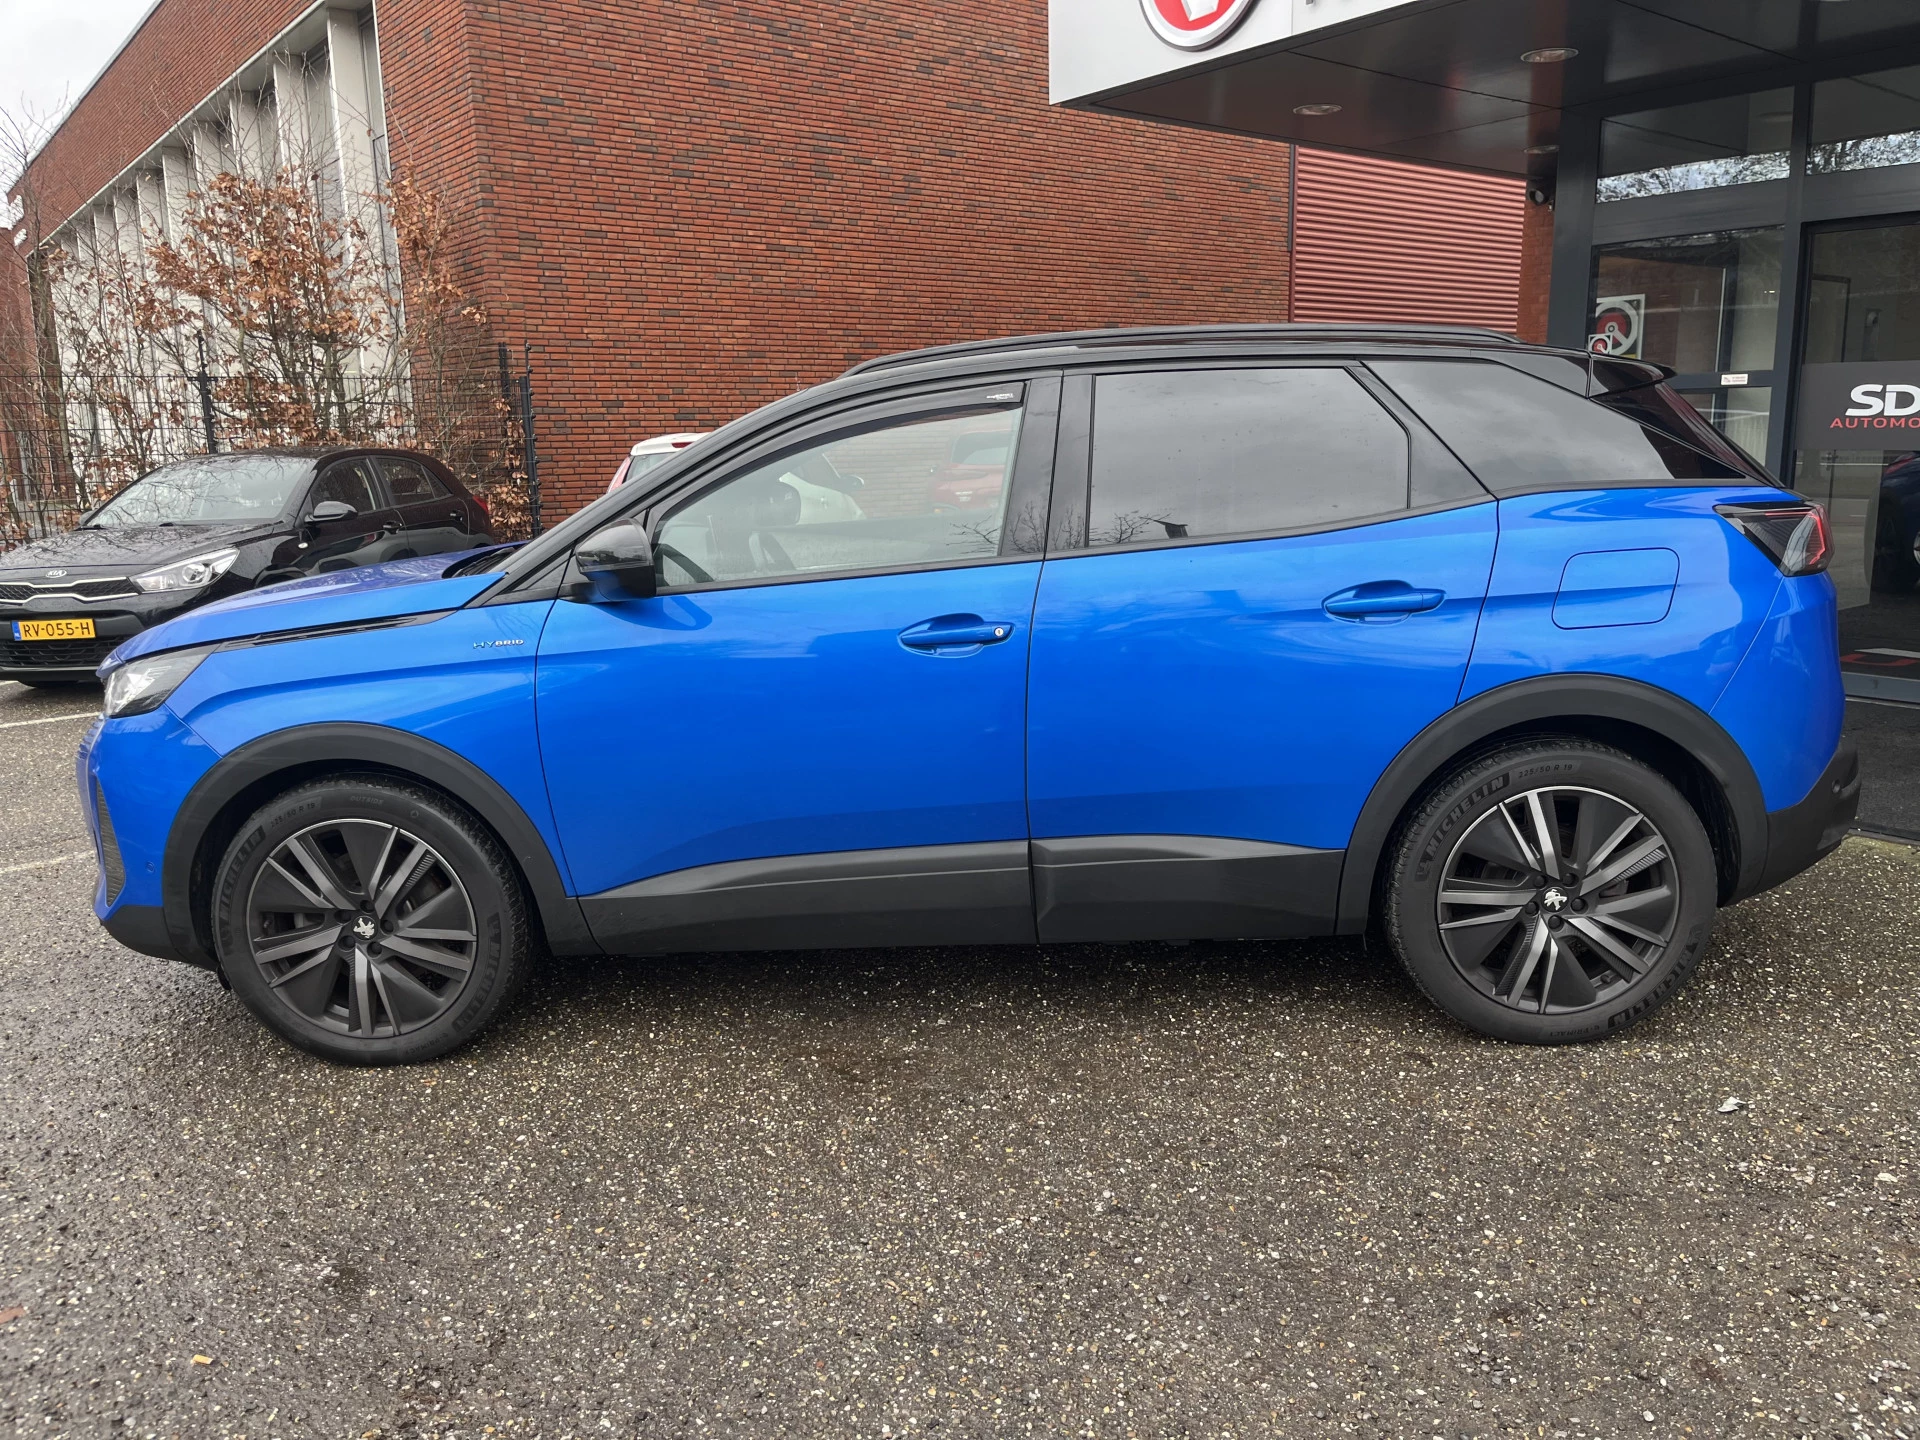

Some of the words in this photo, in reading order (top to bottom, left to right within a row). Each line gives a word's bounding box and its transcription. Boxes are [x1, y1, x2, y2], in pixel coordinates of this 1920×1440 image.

[23, 622, 91, 638] RV-055-H
[473, 639, 524, 649] HYBRID
[1426, 776, 1504, 857] MICHELIN
